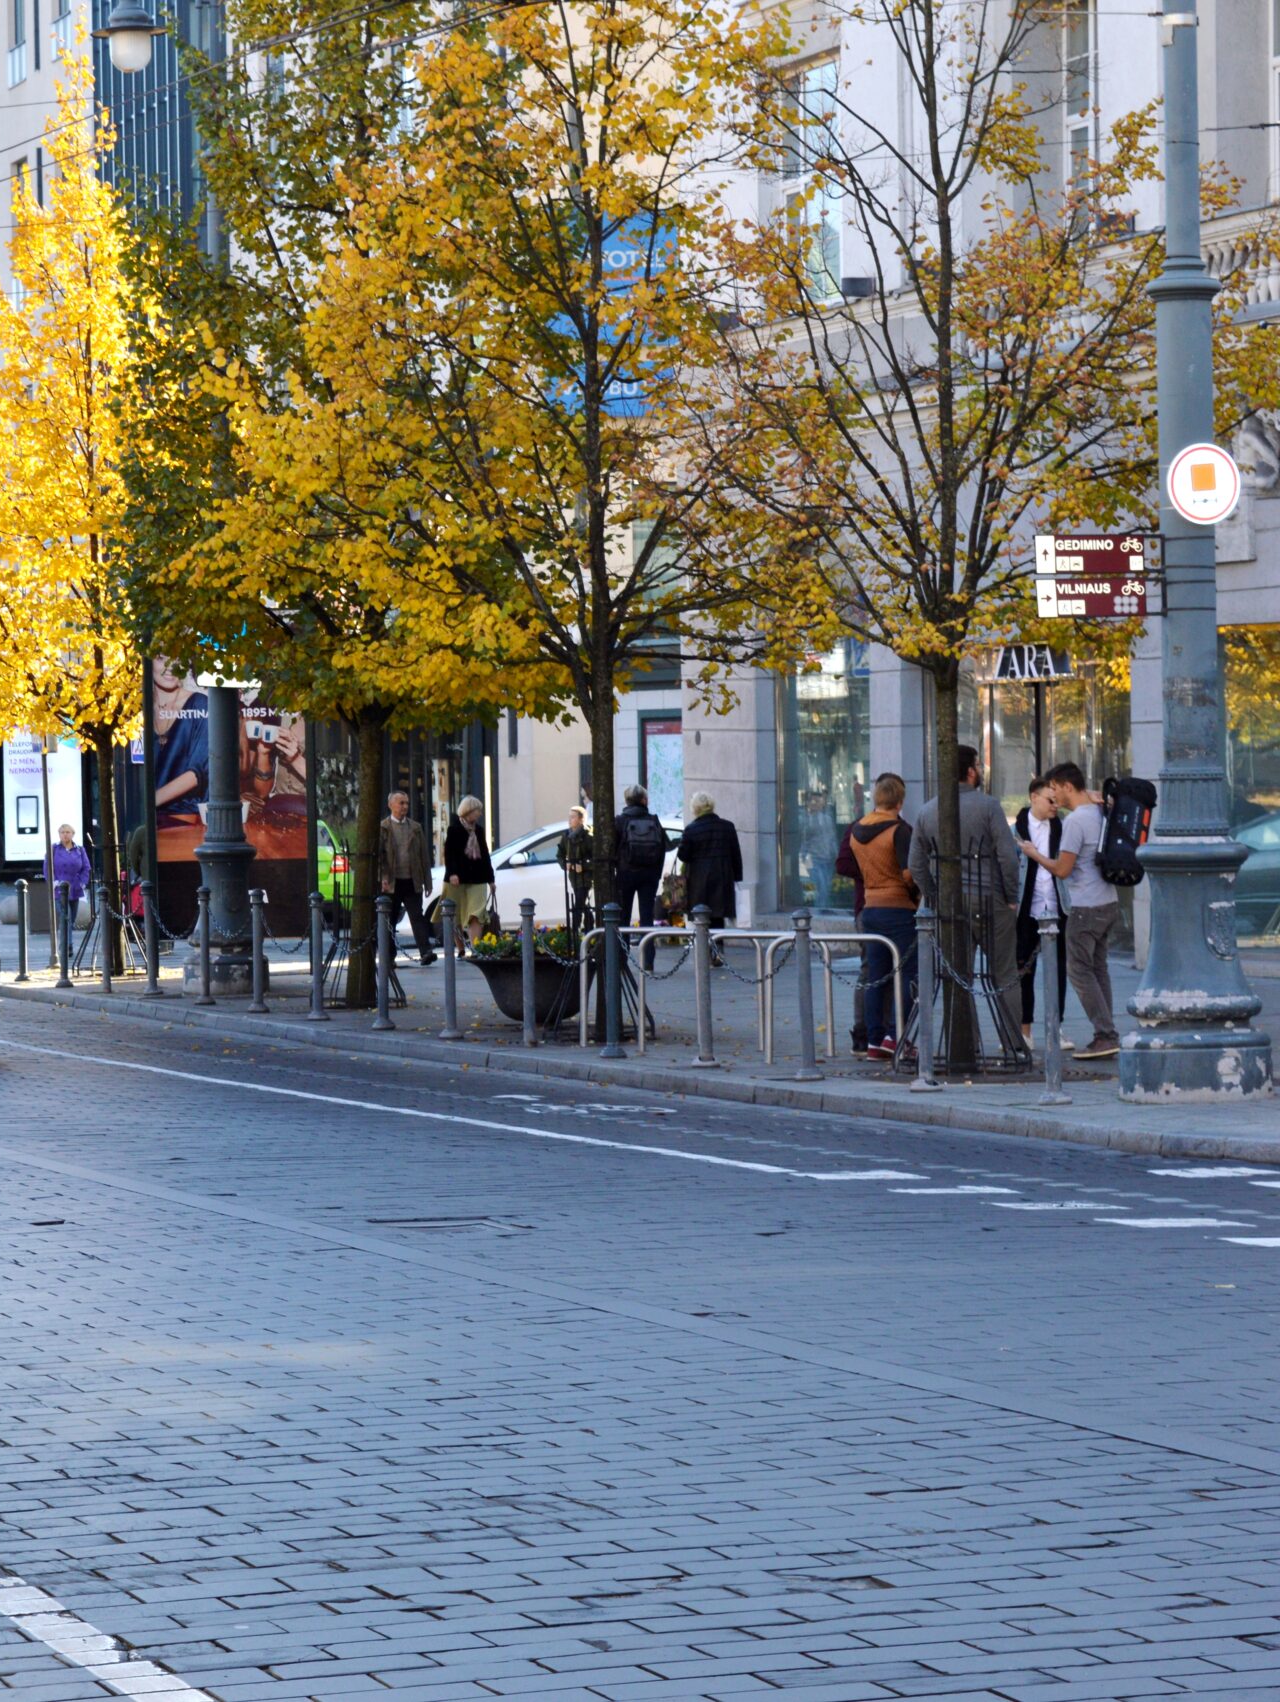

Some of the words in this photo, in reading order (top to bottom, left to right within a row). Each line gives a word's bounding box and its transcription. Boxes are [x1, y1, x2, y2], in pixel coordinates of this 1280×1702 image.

[1055, 539, 1114, 551] GEDIMINO
[1056, 583, 1111, 595] VILNIAUS
[241, 707, 266, 717] 1895
